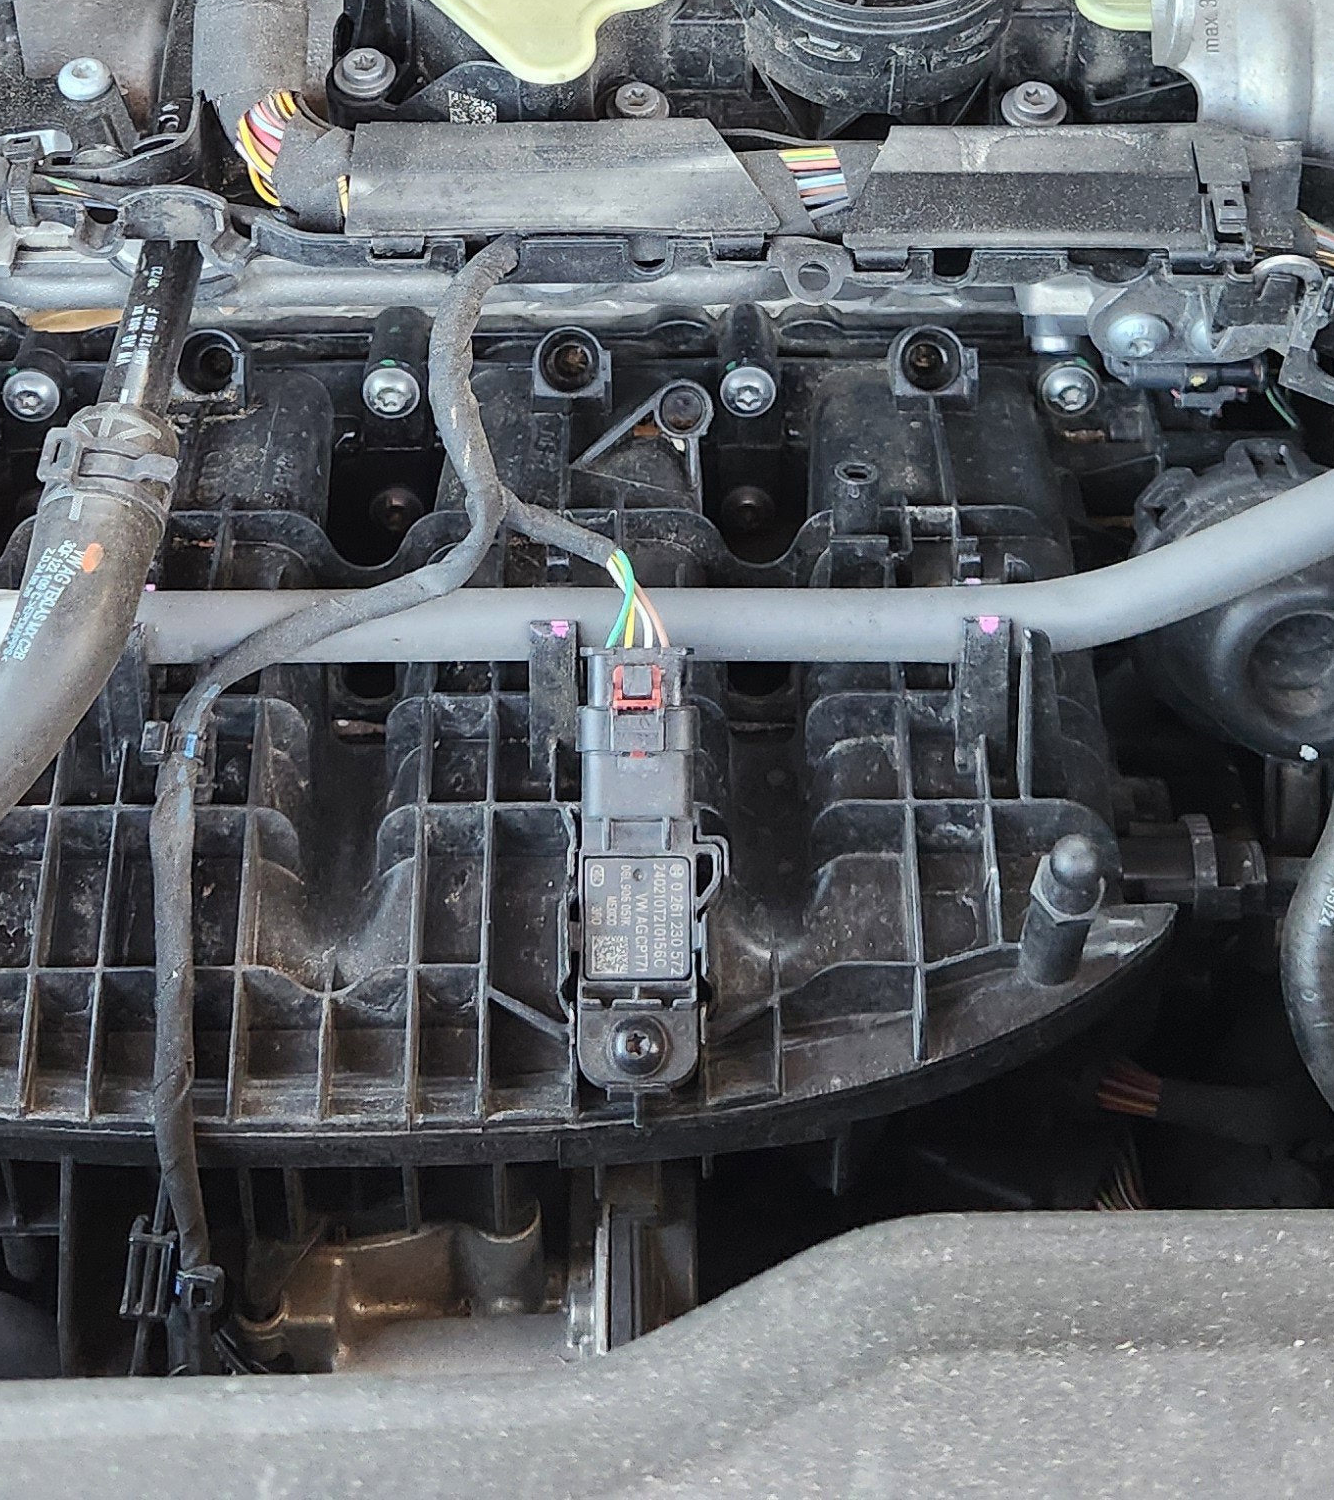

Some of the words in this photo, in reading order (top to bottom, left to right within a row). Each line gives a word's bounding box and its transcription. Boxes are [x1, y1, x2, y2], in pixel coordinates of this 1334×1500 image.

[1203, 13, 1219, 52] max.
[139, 333, 152, 346] 121
[45, 558, 63, 576] 122
[54, 565, 75, 584] AG
[620, 884, 630, 901] 906
[671, 882, 682, 890] 0
[635, 893, 647, 912] VW
[670, 895, 683, 916] 261
[635, 916, 647, 934] AG
[670, 921, 683, 946] 230
[670, 951, 683, 975] 572
